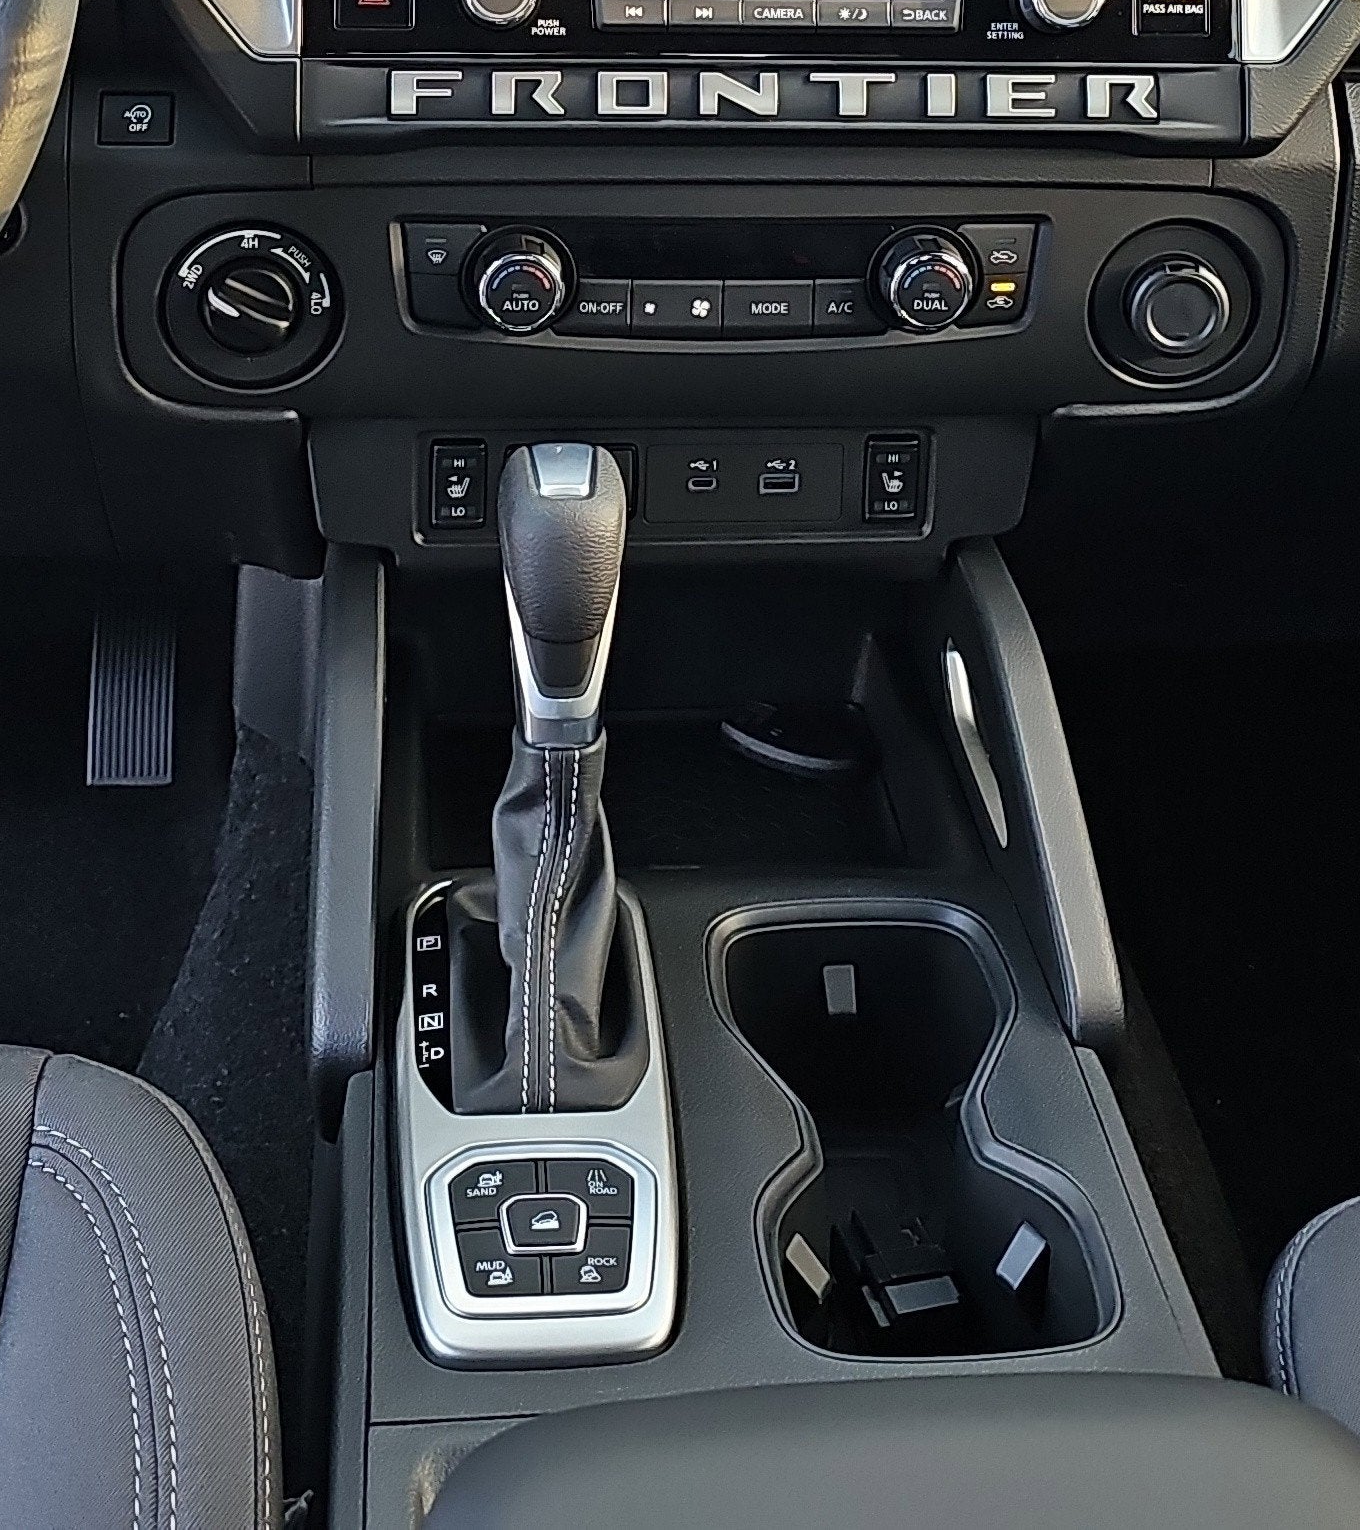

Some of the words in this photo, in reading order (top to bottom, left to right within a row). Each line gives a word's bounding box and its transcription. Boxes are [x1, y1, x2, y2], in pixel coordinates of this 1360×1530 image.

[753, 7, 804, 20] CAMERA
[1143, 3, 1166, 13] PASS
[1167, 4, 1184, 13] AIR
[1184, 4, 1204, 14] BAG
[915, 8, 947, 21] BACK
[537, 19, 559, 27] PUSH
[990, 22, 1019, 31] ENTER
[531, 27, 566, 37] POWER
[986, 31, 1025, 39] SETTING
[390, 70, 1159, 118] FRONTIER
[128, 123, 149, 132] OFF
[240, 237, 259, 249] 4H
[287, 245, 312, 269] PUSH
[182, 264, 203, 290] 2WD
[310, 291, 322, 315] 4LO
[502, 300, 539, 311] AUTO
[751, 302, 789, 314] MODE
[827, 302, 853, 314] A/C
[913, 299, 949, 311] DUAL
[453, 458, 465, 467] HI
[887, 453, 899, 463] HI
[712, 460, 717, 470] 1
[788, 459, 796, 470] 2
[884, 500, 898, 510] LO
[451, 506, 465, 517] LO
[423, 937, 435, 949] P
[423, 983, 437, 997] R
[424, 1015, 439, 1028] N
[431, 1046, 444, 1060] D
[588, 1180, 605, 1189] ON
[466, 1186, 497, 1198] SAND
[589, 1186, 617, 1195] ROAD
[476, 1260, 505, 1271] MUD
[587, 1256, 618, 1267] ROCK
